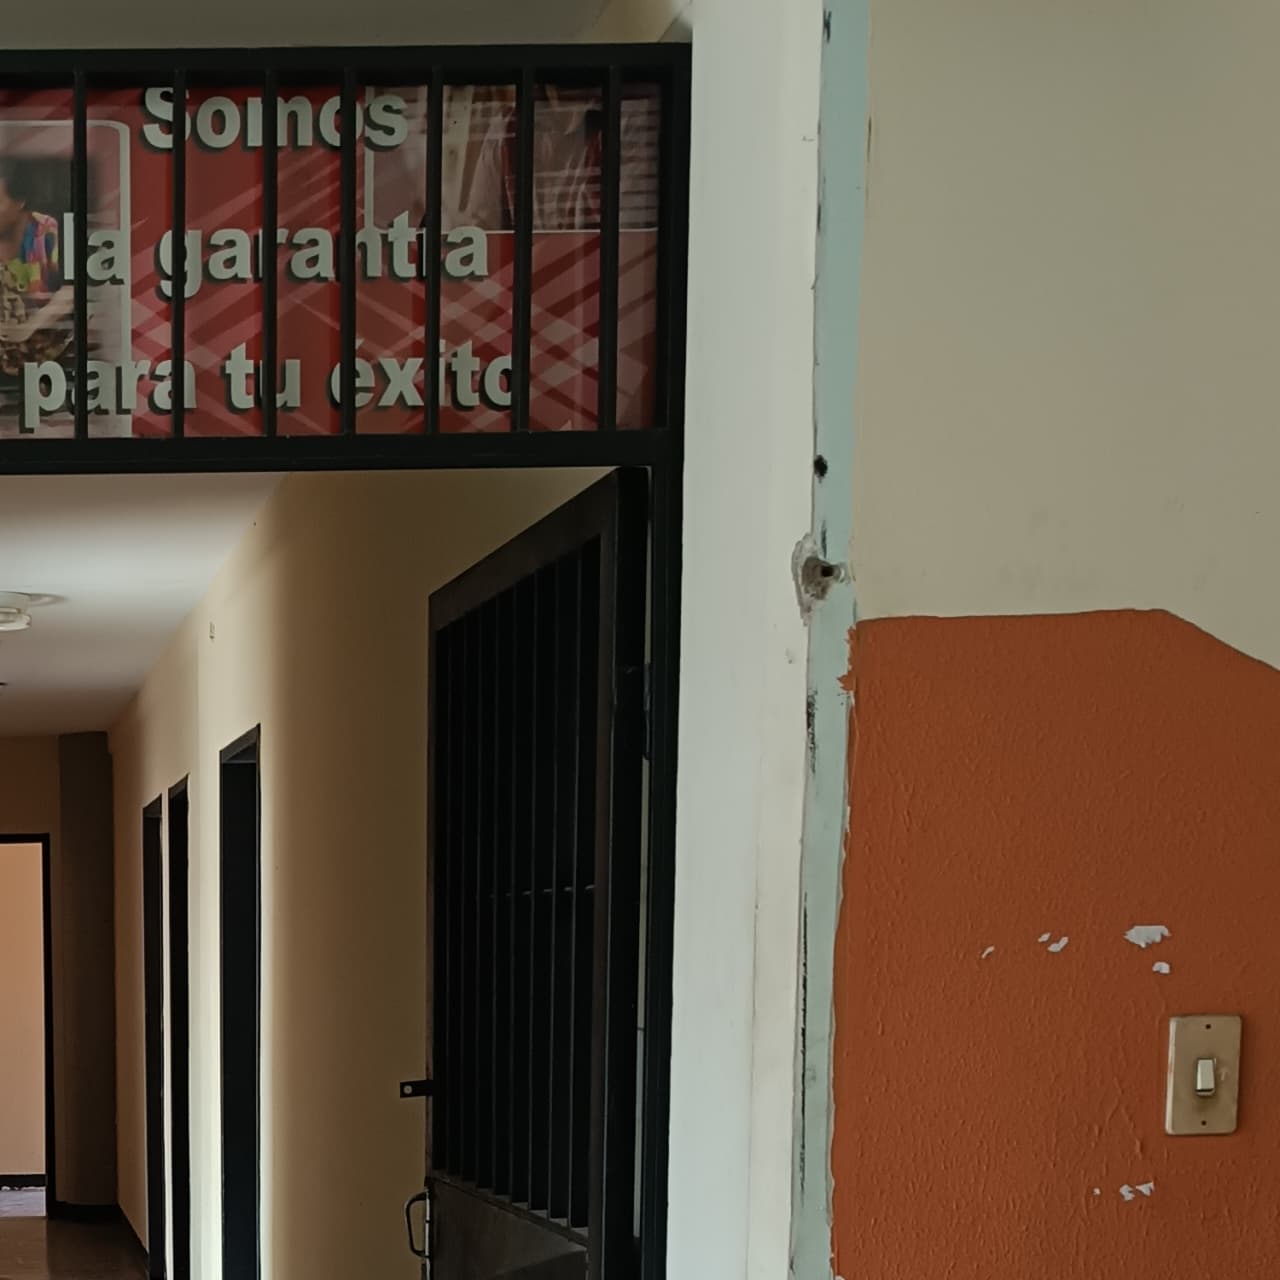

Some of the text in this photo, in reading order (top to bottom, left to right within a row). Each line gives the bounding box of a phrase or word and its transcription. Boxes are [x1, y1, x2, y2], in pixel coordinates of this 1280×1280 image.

[143, 86, 409, 149] Somos
[63, 212, 124, 281] la
[22, 361, 197, 429] para
[224, 343, 302, 409] tu
